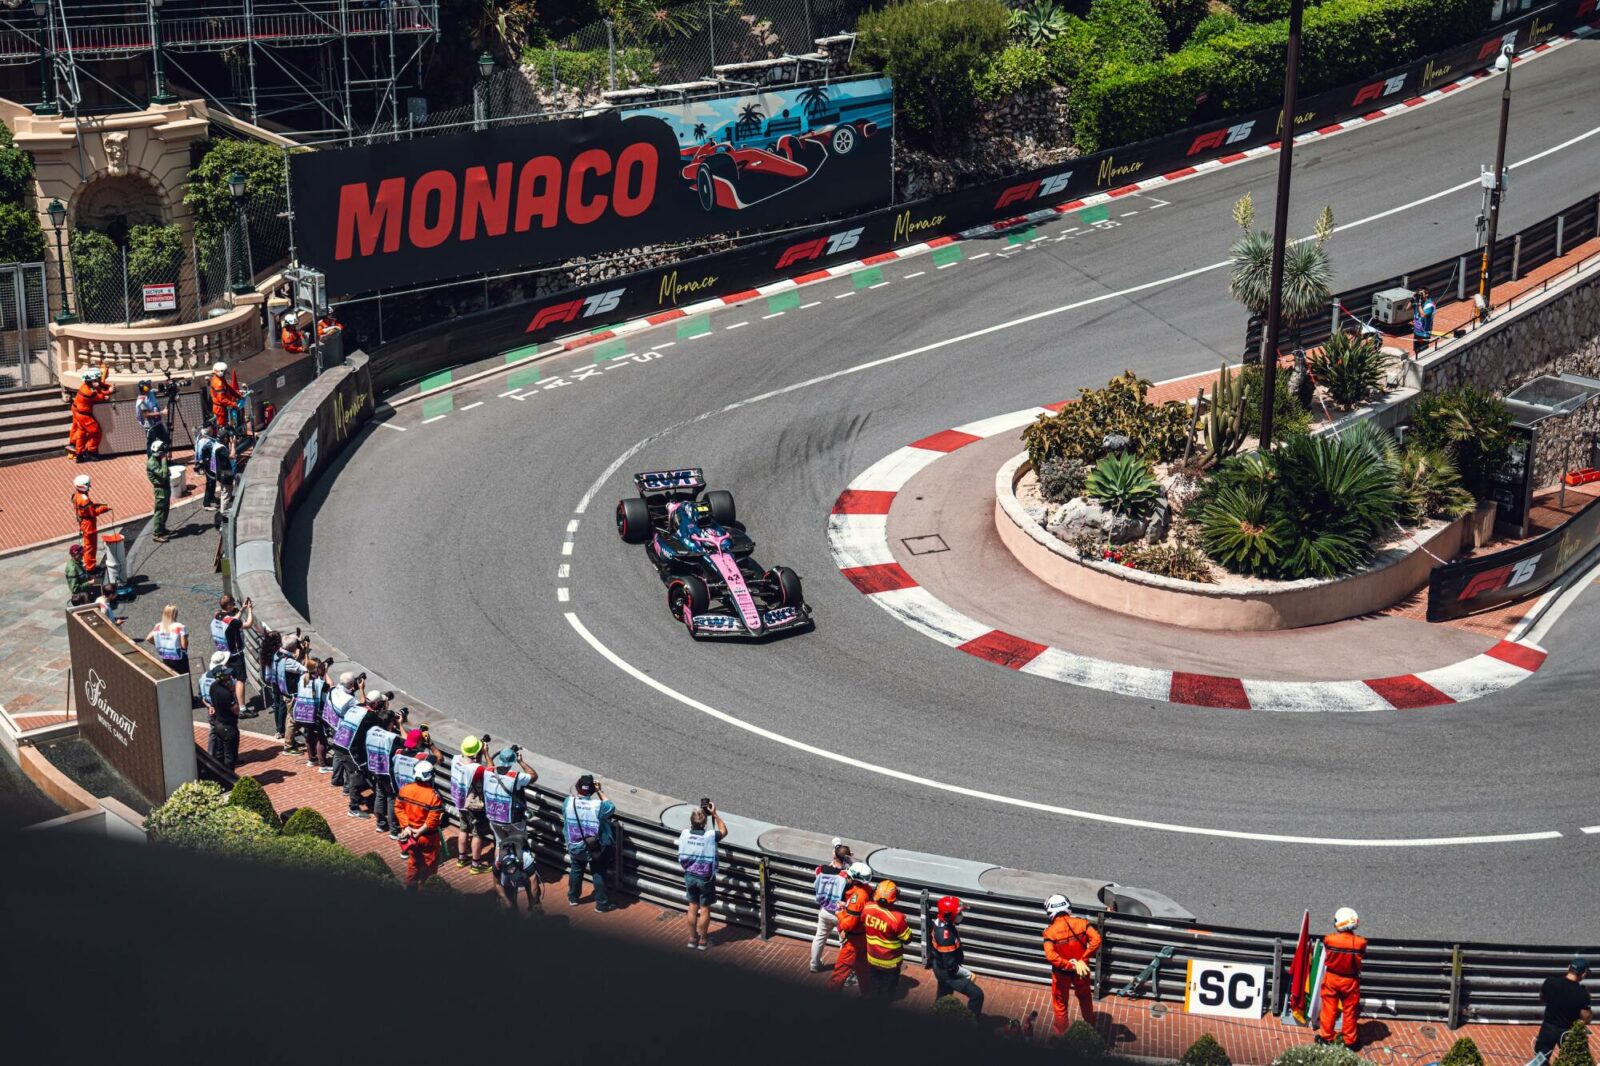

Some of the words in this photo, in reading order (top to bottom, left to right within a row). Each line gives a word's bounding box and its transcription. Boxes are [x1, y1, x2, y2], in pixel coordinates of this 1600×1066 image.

[1275, 109, 1317, 136] Mnaco
[1097, 155, 1144, 187] Monaco
[334, 142, 659, 261] MONACO
[893, 209, 947, 243] Monaco
[658, 270, 719, 306] Monaco
[509, 351, 664, 401] TAXIS
[84, 668, 138, 741] Fairmont
[97, 713, 113, 734] MONTE
[865, 914, 888, 933] CSPM
[1198, 969, 1256, 1010] SC
